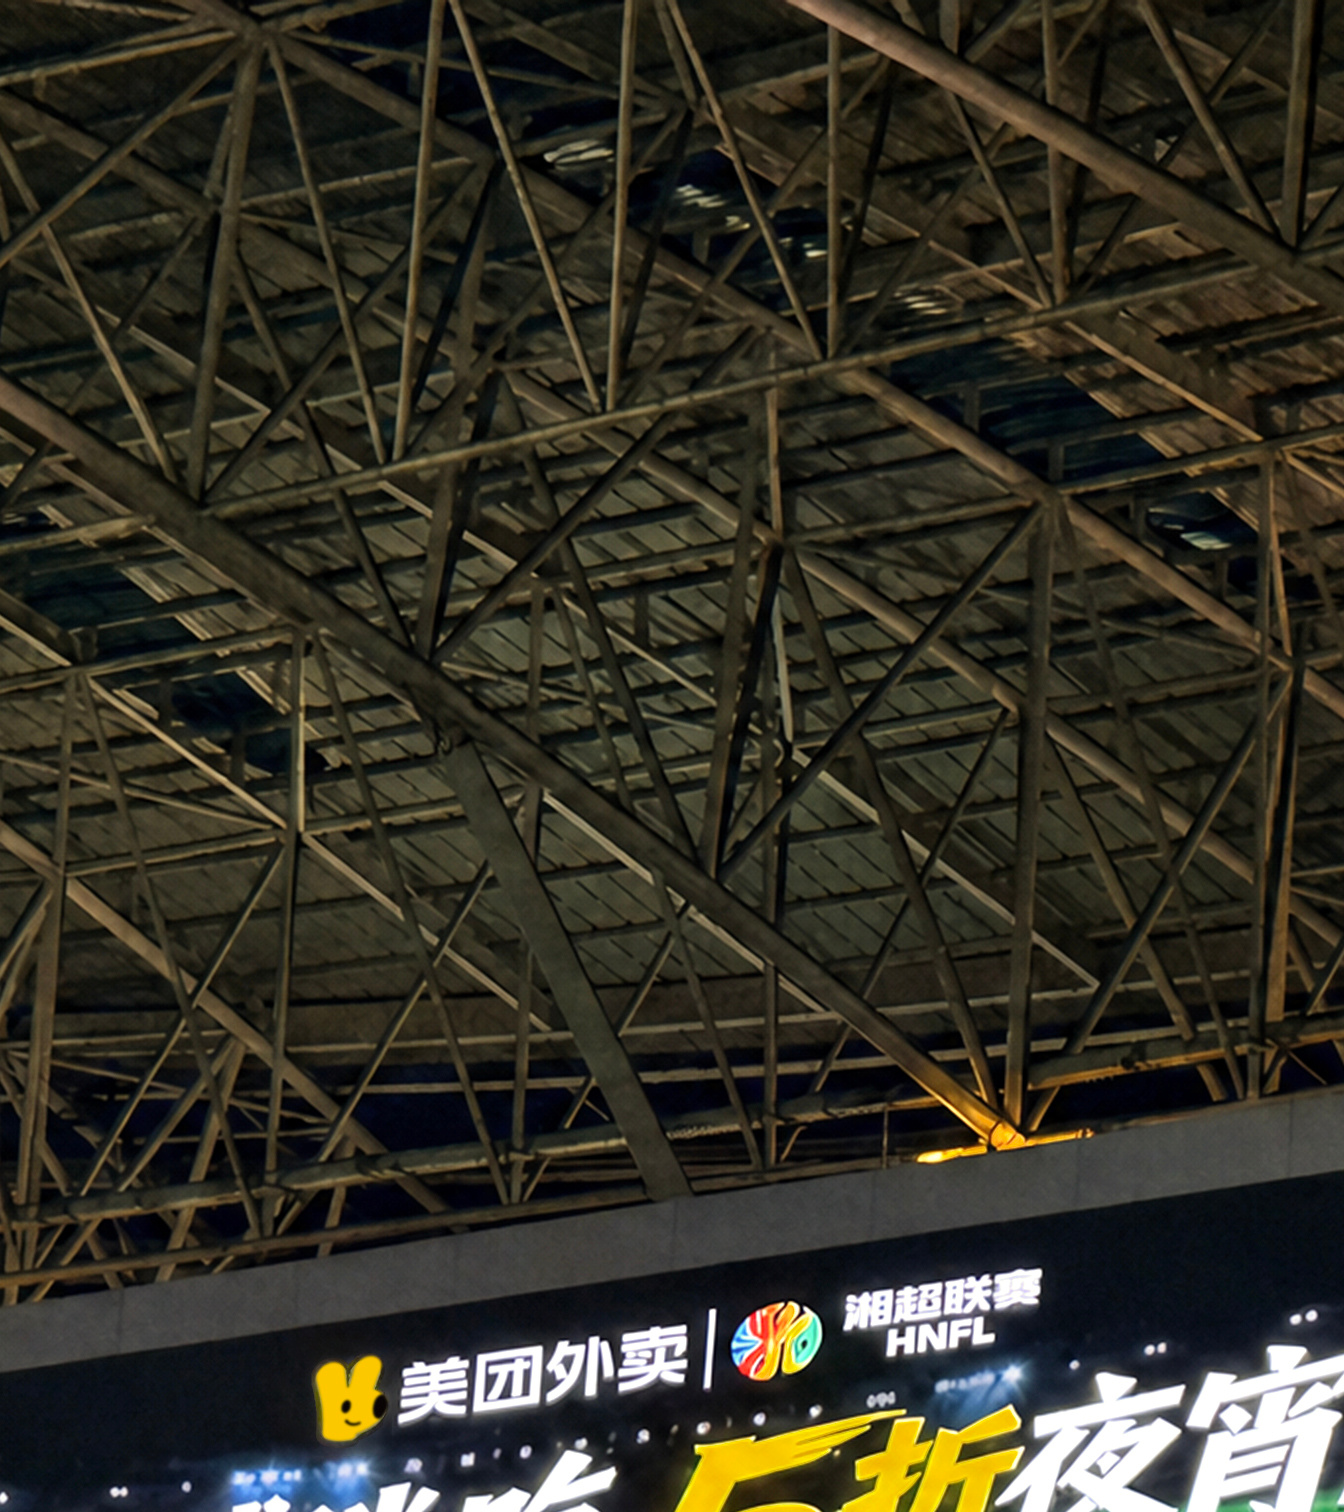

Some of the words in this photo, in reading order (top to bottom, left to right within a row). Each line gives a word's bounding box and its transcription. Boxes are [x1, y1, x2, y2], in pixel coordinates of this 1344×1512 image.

[844, 1268, 1044, 1331] 湘超联赛
[886, 1323, 998, 1358] HNFL
[398, 1325, 690, 1424] 美团外卖
